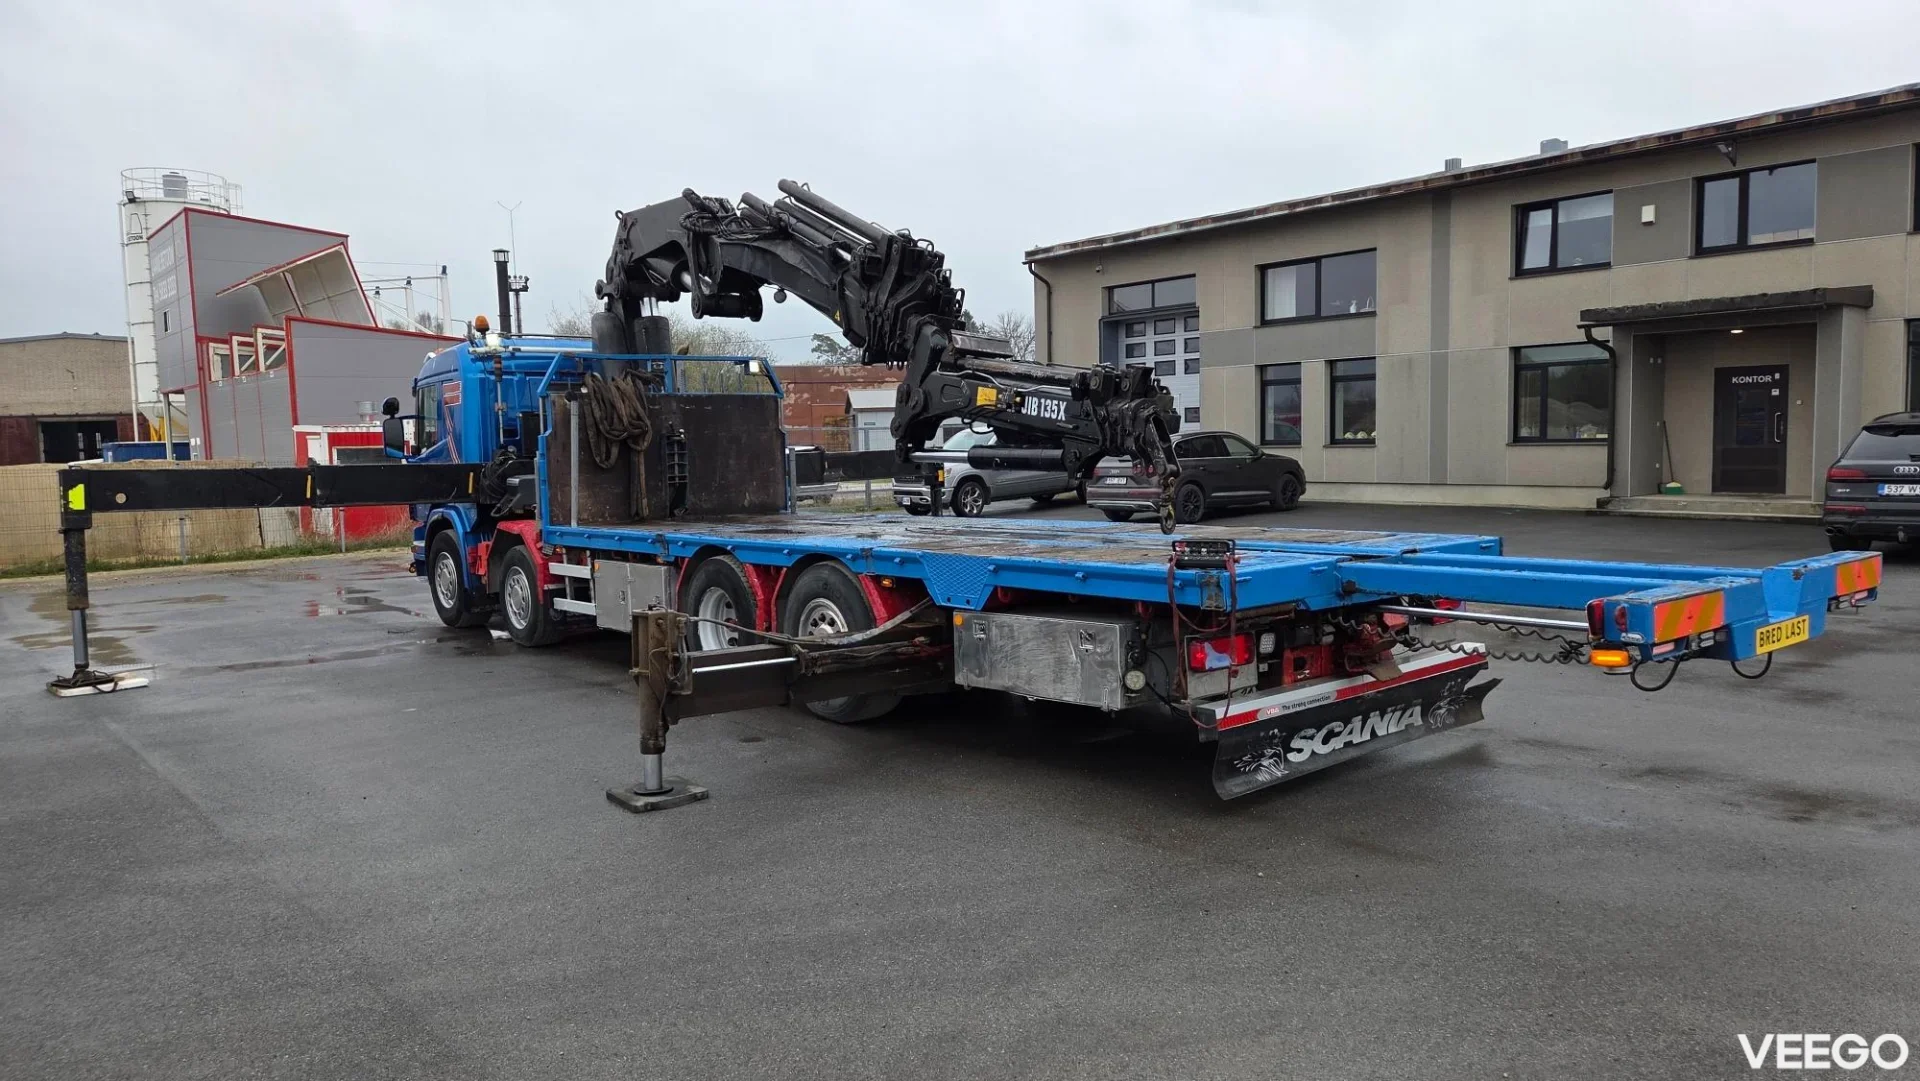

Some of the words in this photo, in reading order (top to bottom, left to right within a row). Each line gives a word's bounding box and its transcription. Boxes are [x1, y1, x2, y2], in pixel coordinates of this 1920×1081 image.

[1732, 374, 1773, 384] KONTOR
[1021, 395, 1039, 417] JIB
[1040, 397, 1067, 421] 135X
[1887, 485, 1905, 493] 537
[1759, 626, 1782, 648] BRED
[1785, 618, 1807, 640] LAST
[1291, 701, 1307, 709] strong
[1307, 695, 1331, 707] connection
[1286, 702, 1423, 762] SCANIA
